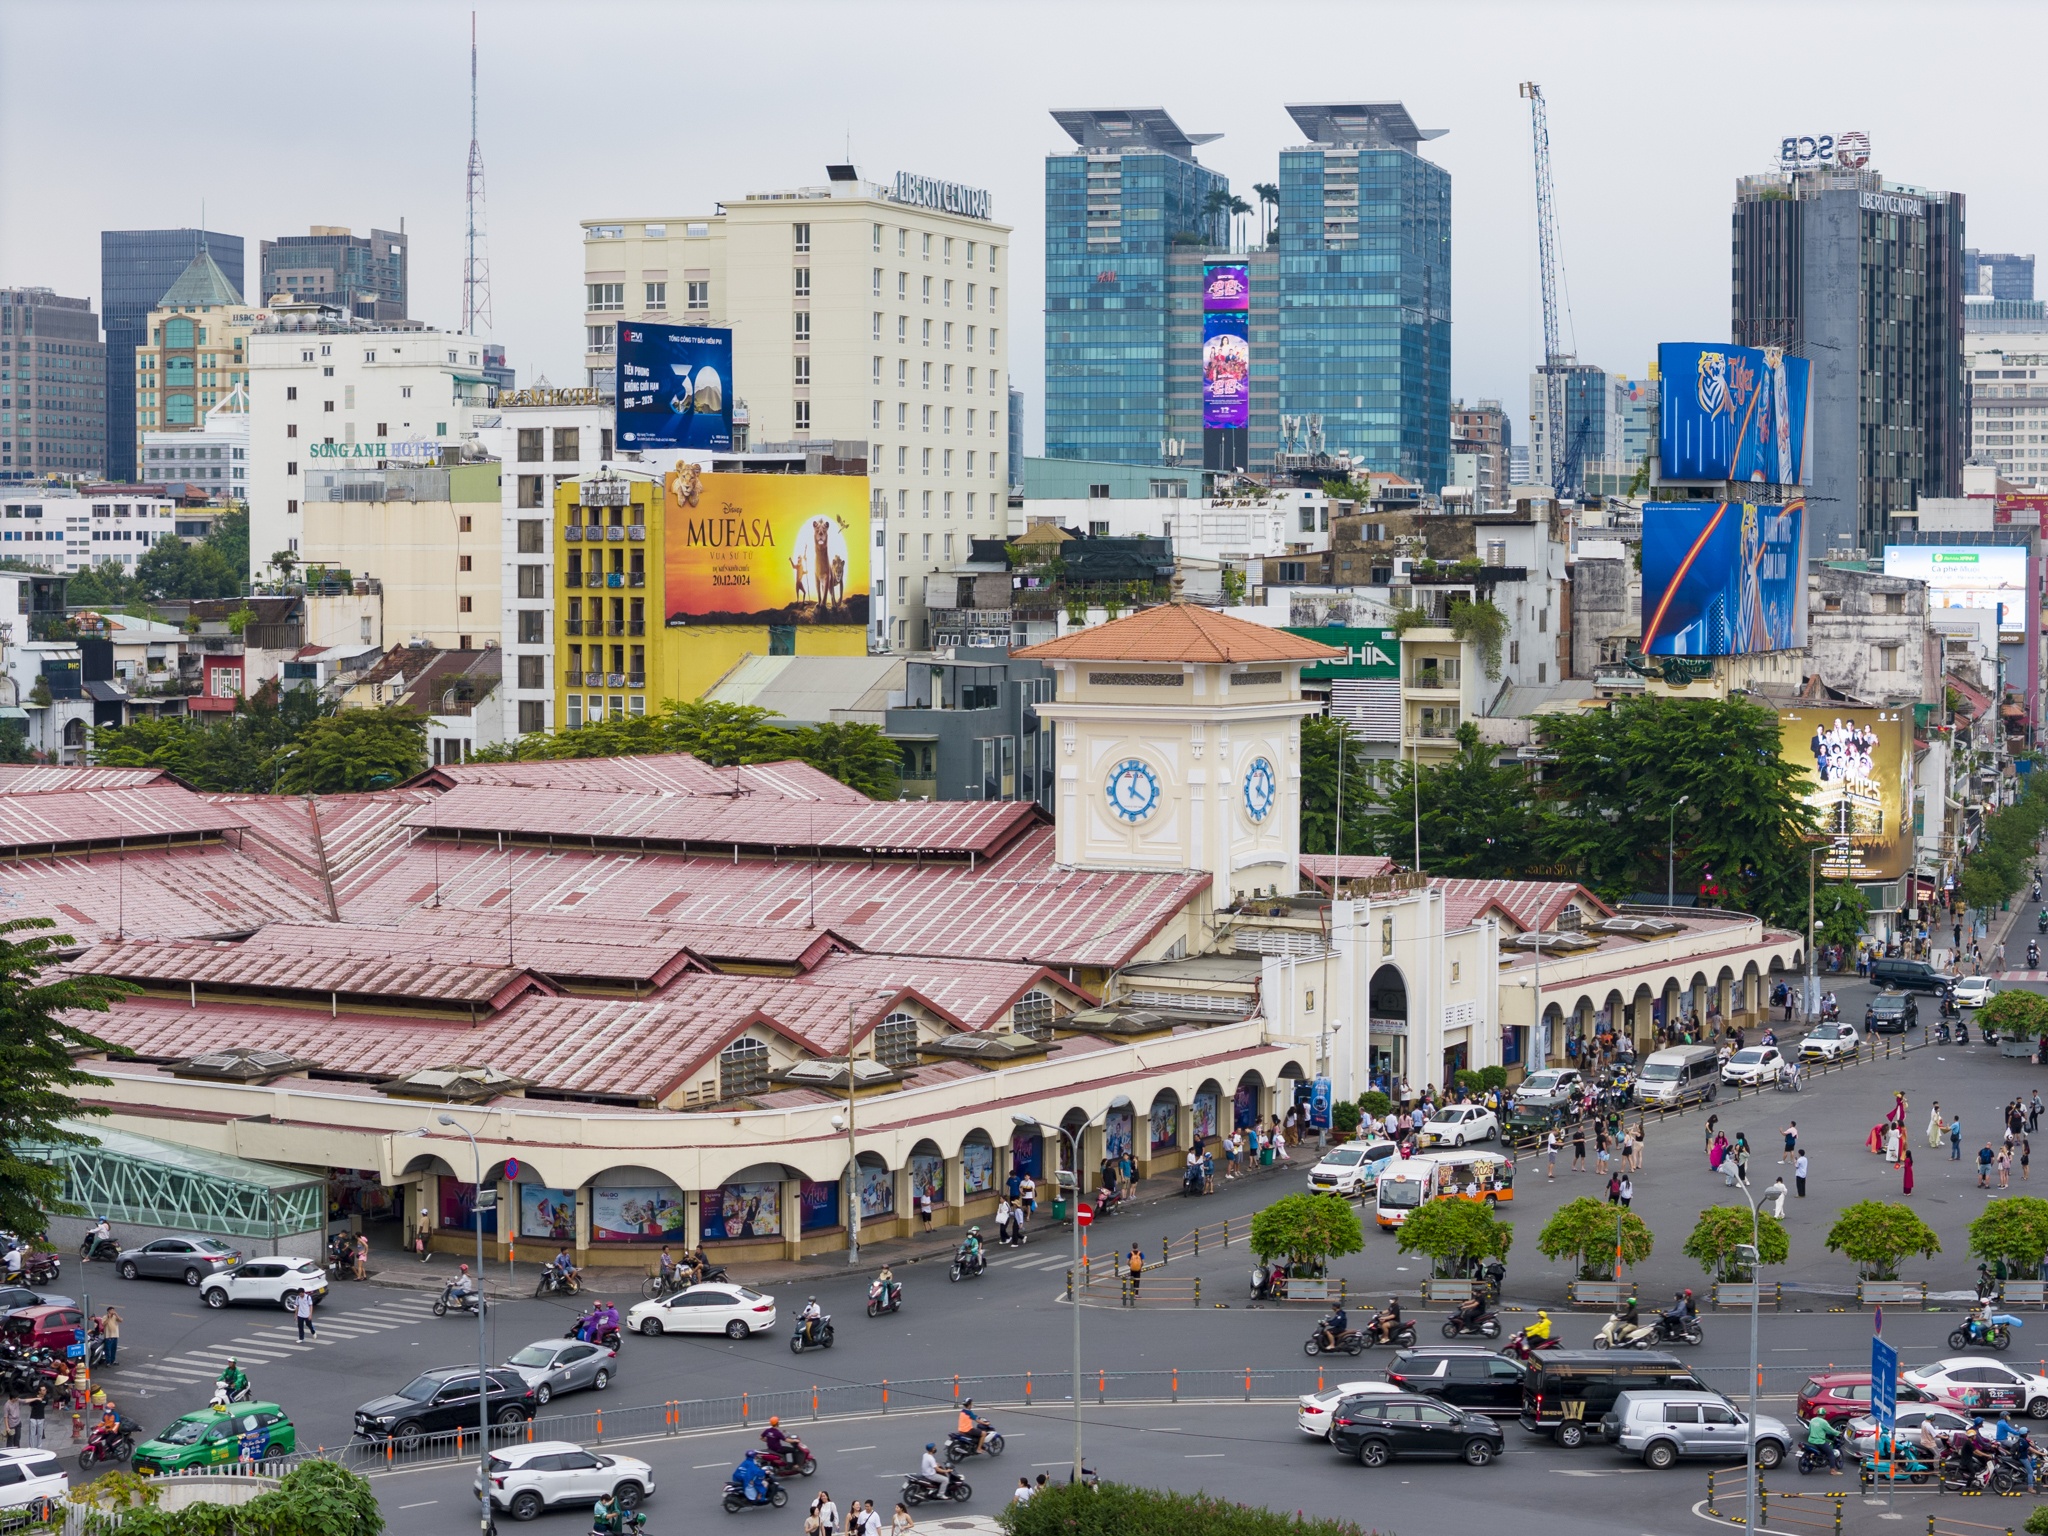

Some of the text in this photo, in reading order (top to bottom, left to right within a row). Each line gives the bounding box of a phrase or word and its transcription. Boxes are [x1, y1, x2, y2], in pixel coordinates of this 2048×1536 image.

[898, 171, 992, 219] LIBERTY CENTRAL
[1859, 192, 1922, 215] LIBERTY CENTRAL
[1728, 355, 1754, 406] Tiger
[549, 387, 605, 405] HOTEL
[310, 442, 443, 457] SONG ANH HOTEL
[722, 502, 743, 516] Disney
[686, 518, 776, 547] MUFASA
[713, 574, 750, 586] 20.12.2024
[1845, 776, 1881, 800] 2025
[1474, 1165, 1494, 1176] 2025
[802, 1184, 827, 1205] Vikki
